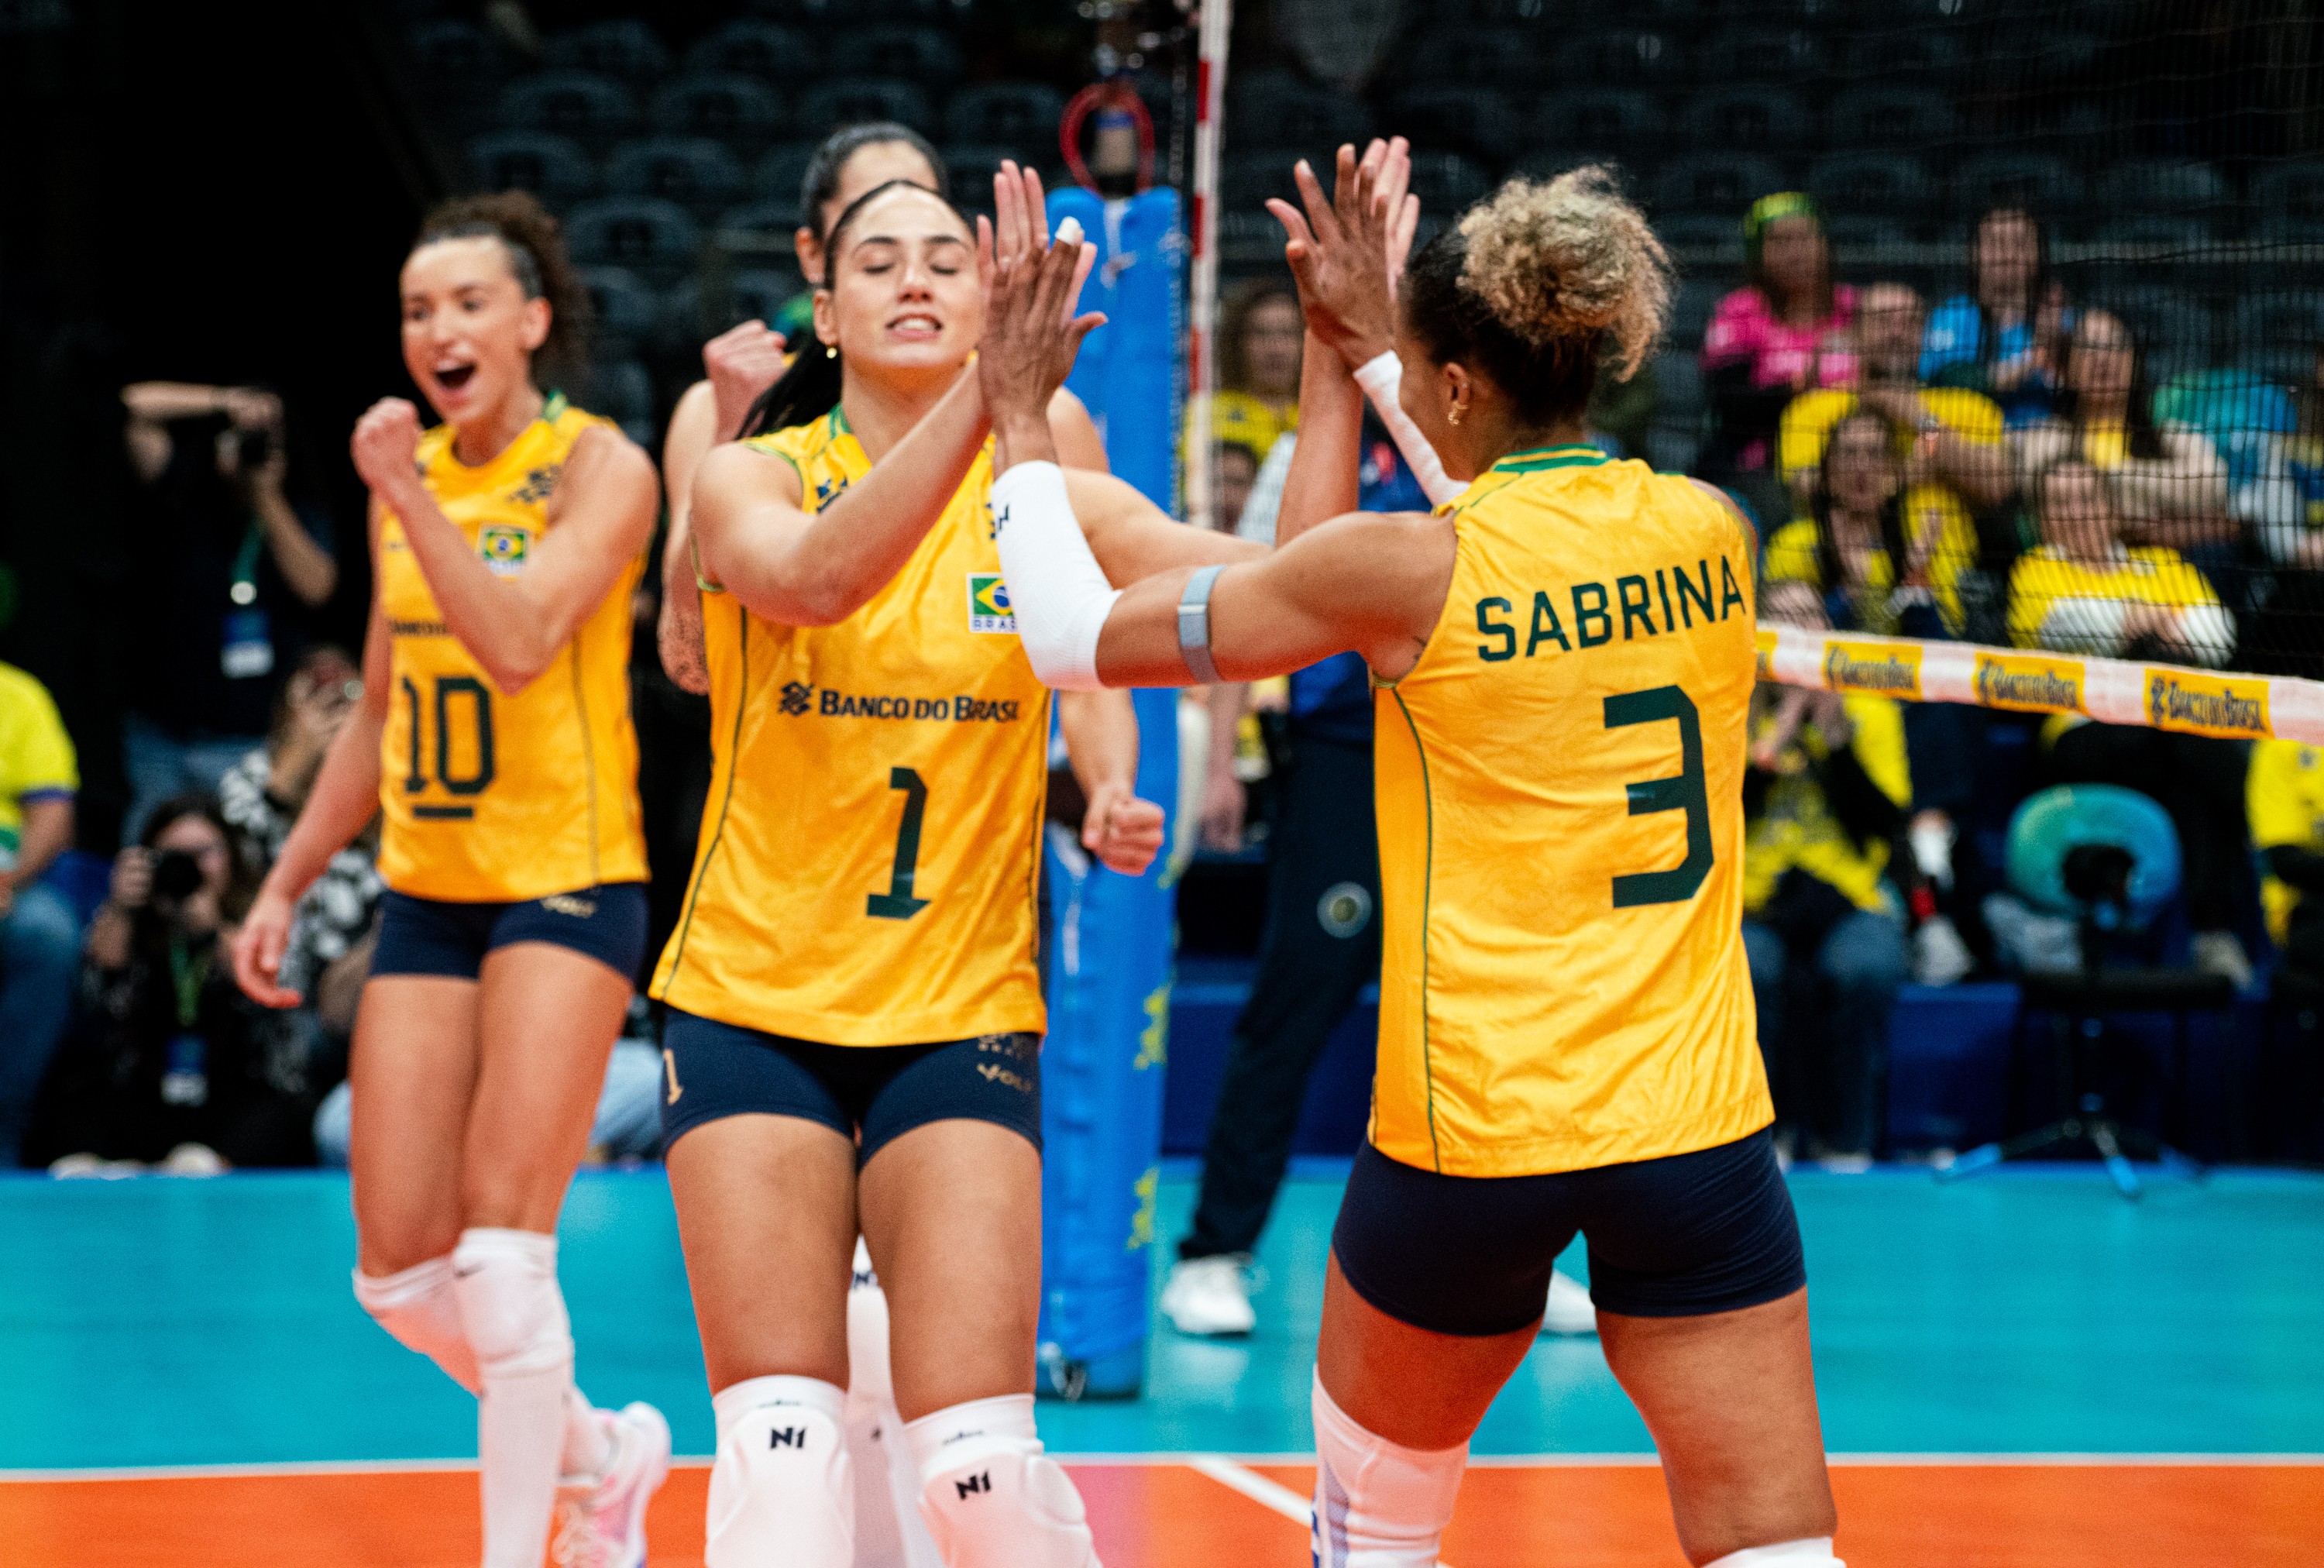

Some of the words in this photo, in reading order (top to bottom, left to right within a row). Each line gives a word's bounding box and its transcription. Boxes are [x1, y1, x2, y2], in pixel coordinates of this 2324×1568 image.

[1476, 555, 1746, 662] SABRINA
[402, 675, 496, 796] 10
[819, 689, 910, 720] BANCO
[914, 697, 949, 721] DO
[866, 766, 933, 920] 1
[1603, 685, 1714, 908] 3
[663, 1048, 684, 1106] 1
